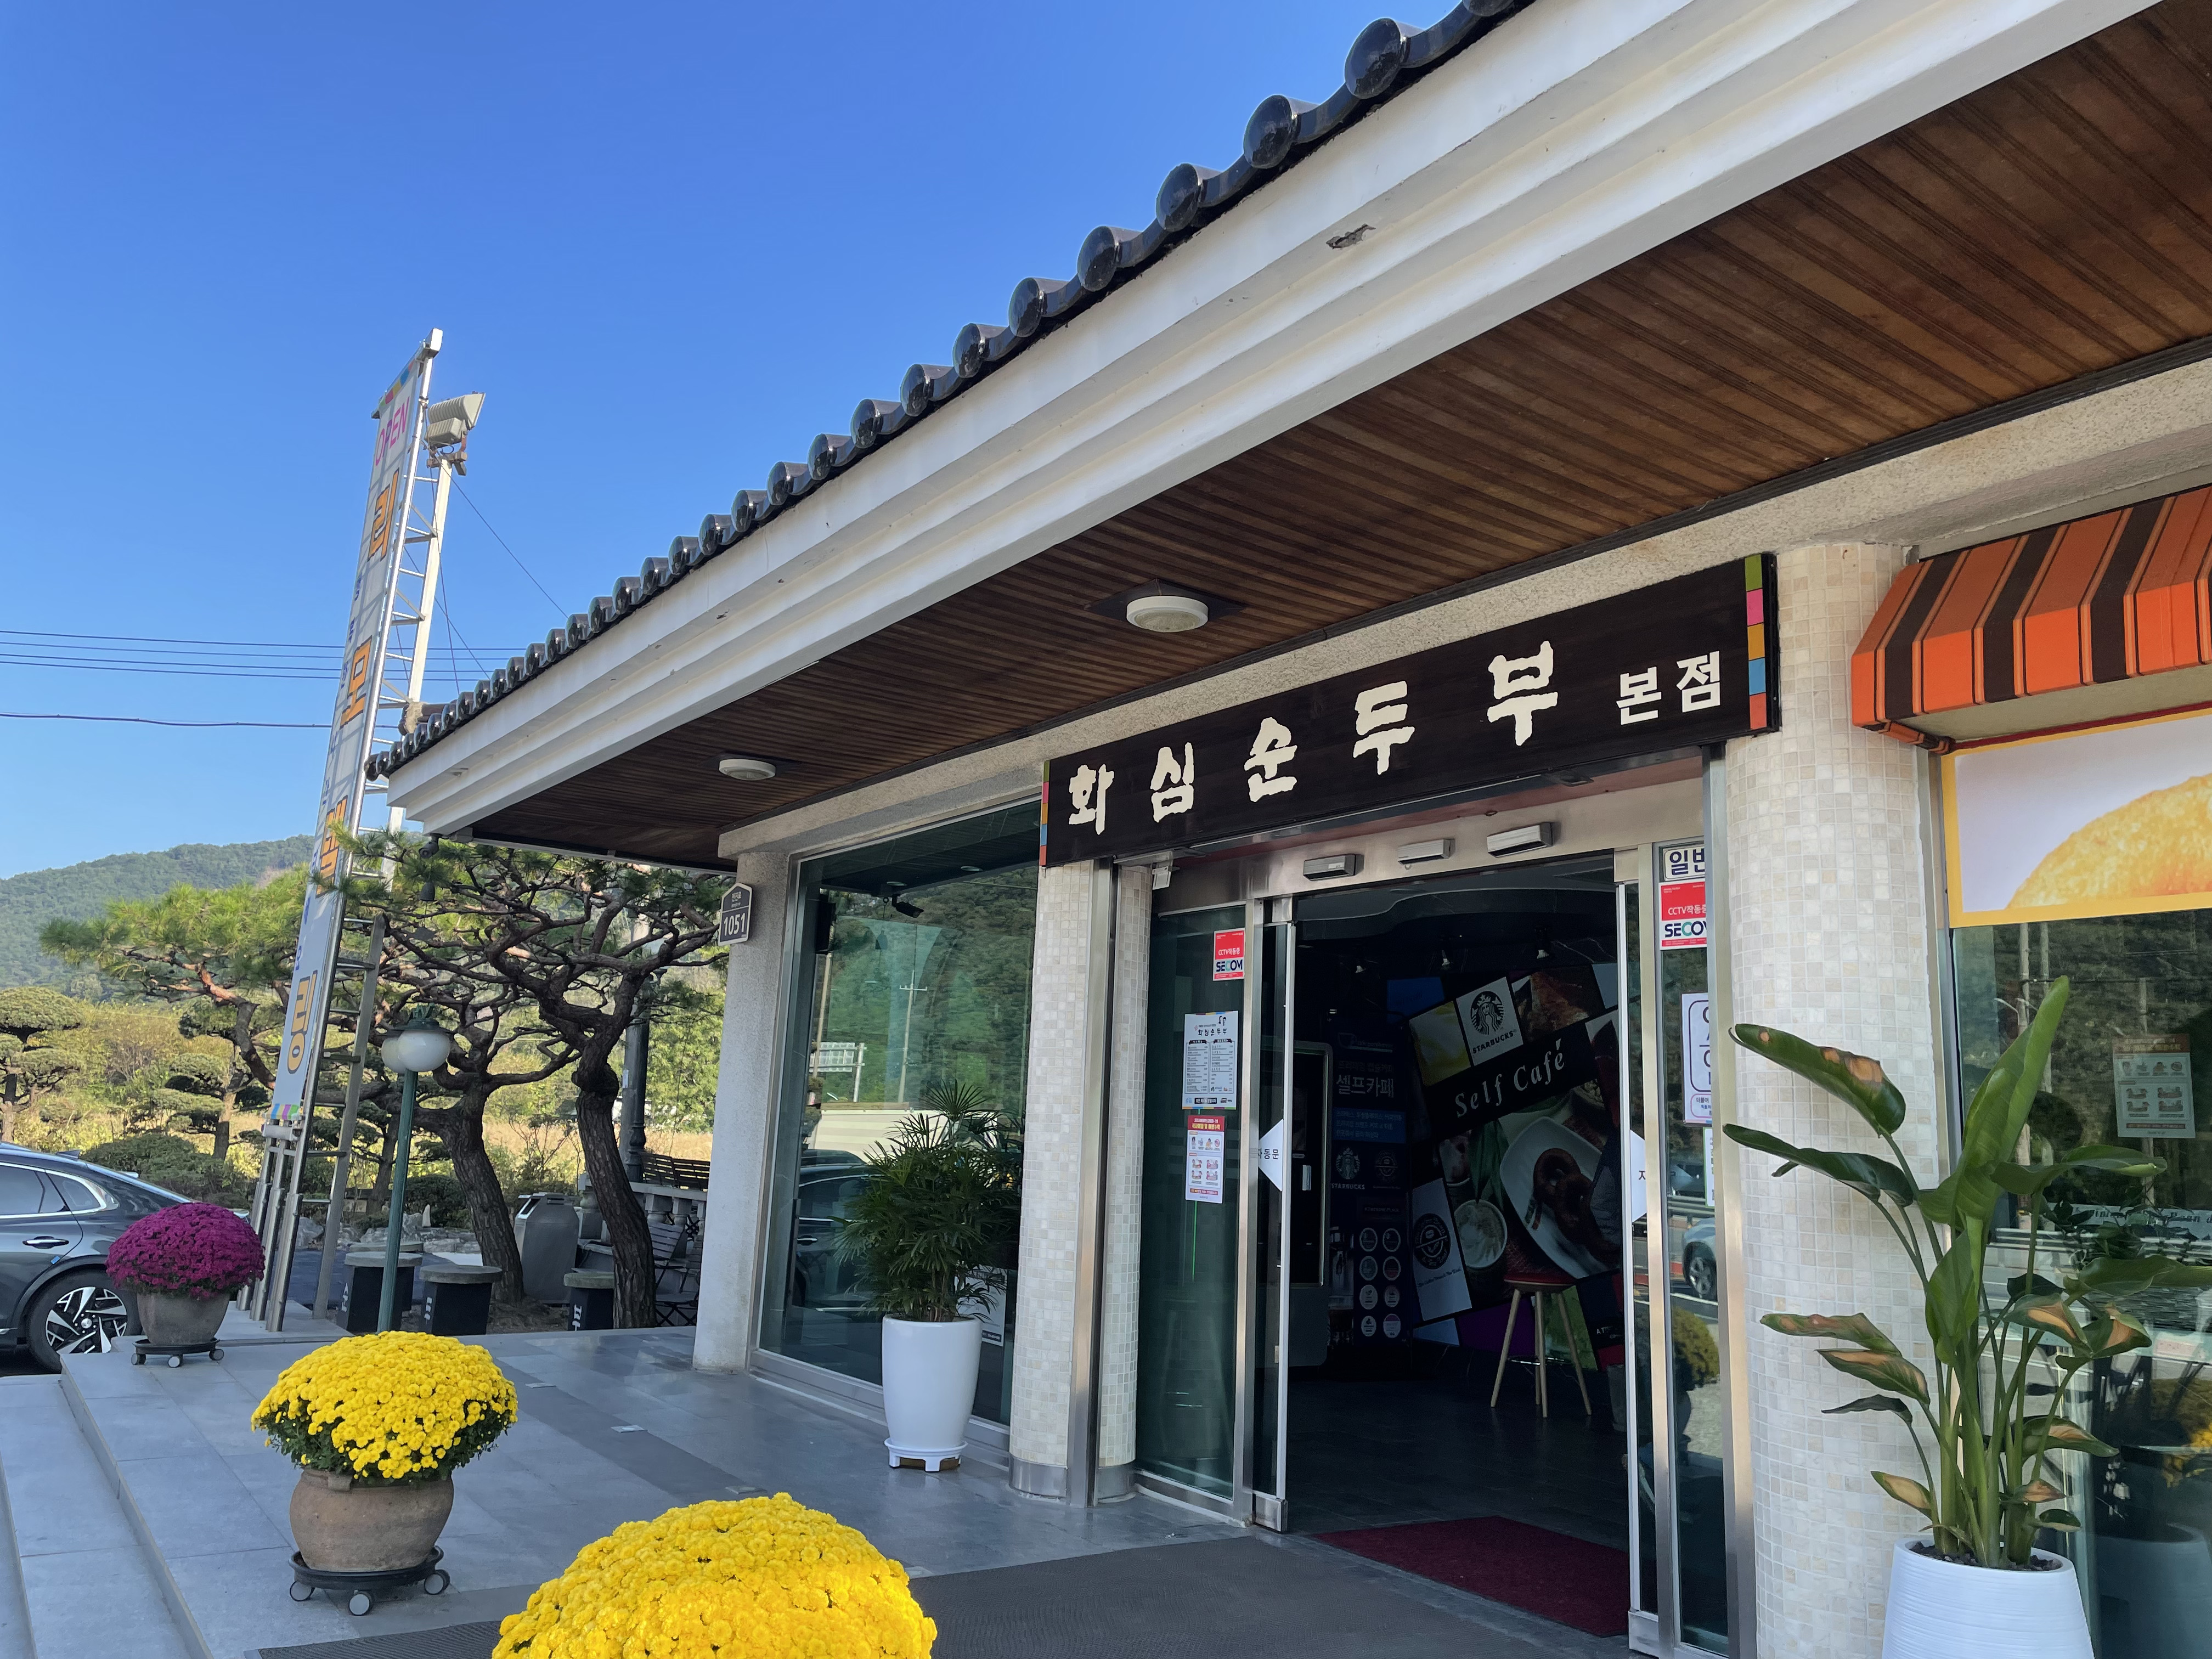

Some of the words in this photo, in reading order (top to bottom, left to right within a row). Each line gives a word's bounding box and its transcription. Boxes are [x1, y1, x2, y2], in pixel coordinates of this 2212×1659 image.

[376, 396, 410, 466] OPEN
[1068, 640, 1558, 834] 화심순두부
[1616, 651, 1722, 725] 본점
[287, 467, 399, 1074] 리모델링
[724, 913, 745, 936] 1051
[1216, 960, 1243, 972] SECOM
[1472, 1031, 1514, 1054] STARBUCKS
[1336, 1074, 1394, 1098] 셀프카페
[1455, 1074, 1503, 1118] Self
[1514, 1038, 1566, 1092] Café
